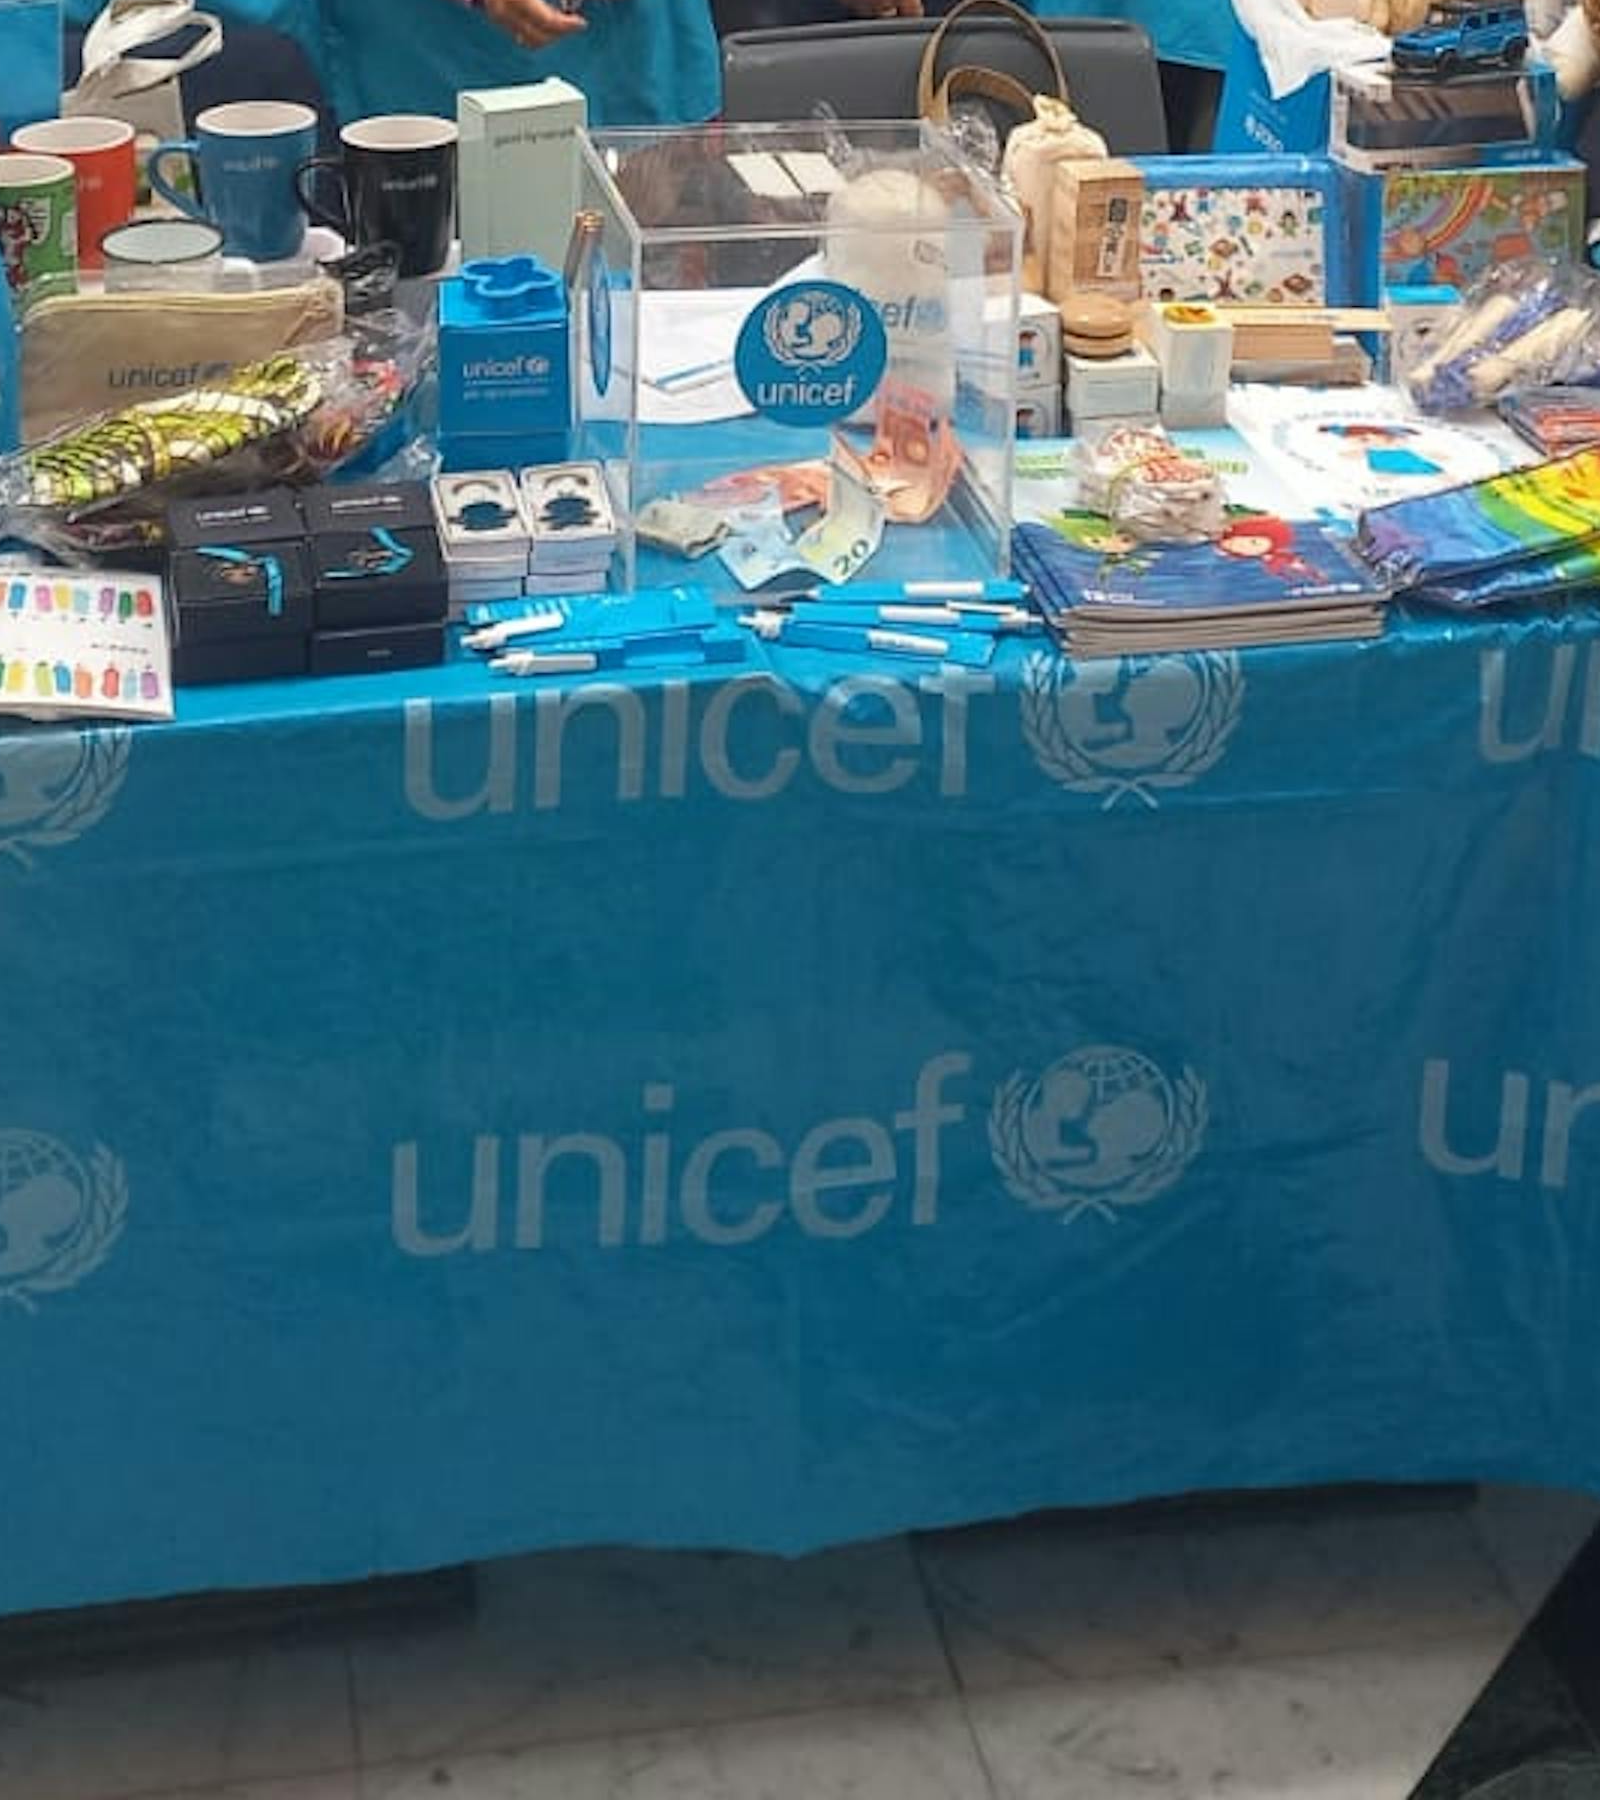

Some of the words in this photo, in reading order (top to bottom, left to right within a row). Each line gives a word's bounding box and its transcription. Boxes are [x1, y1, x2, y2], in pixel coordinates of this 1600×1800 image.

[108, 364, 199, 391] unicef
[462, 359, 524, 380] unicef
[757, 371, 856, 407] unicef
[403, 664, 995, 822] unicef
[391, 1051, 973, 1258] unicef
